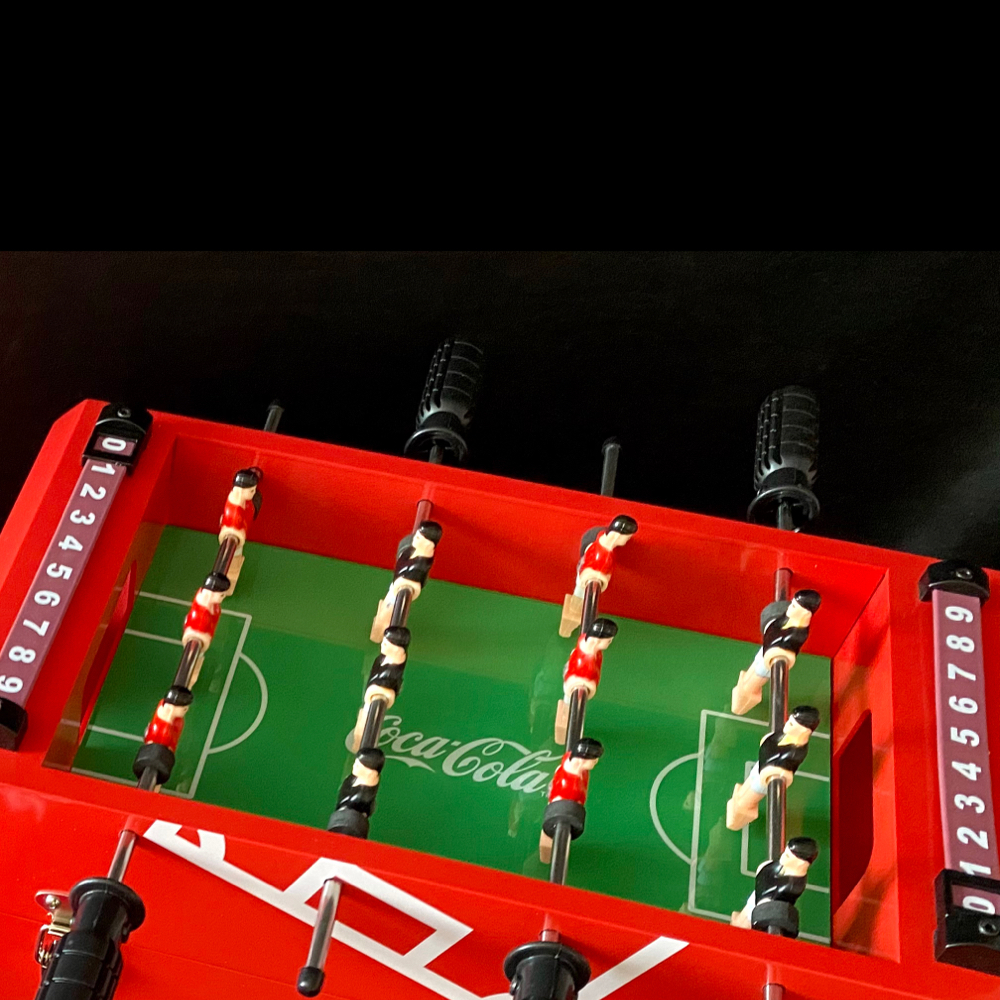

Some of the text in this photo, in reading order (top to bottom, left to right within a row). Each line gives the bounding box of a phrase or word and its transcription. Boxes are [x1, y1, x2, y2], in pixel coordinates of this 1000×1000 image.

[102, 437, 127, 452] 0
[91, 463, 116, 475] 1
[79, 483, 107, 500] 2
[69, 509, 96, 525] 3
[58, 534, 83, 552] 4
[46, 562, 73, 580] 5
[34, 590, 61, 607] 6
[22, 619, 50, 637] 7
[8, 645, 36, 664] 8
[944, 605, 996, 915] 9 8 7 6 5 4 3 2 1 0
